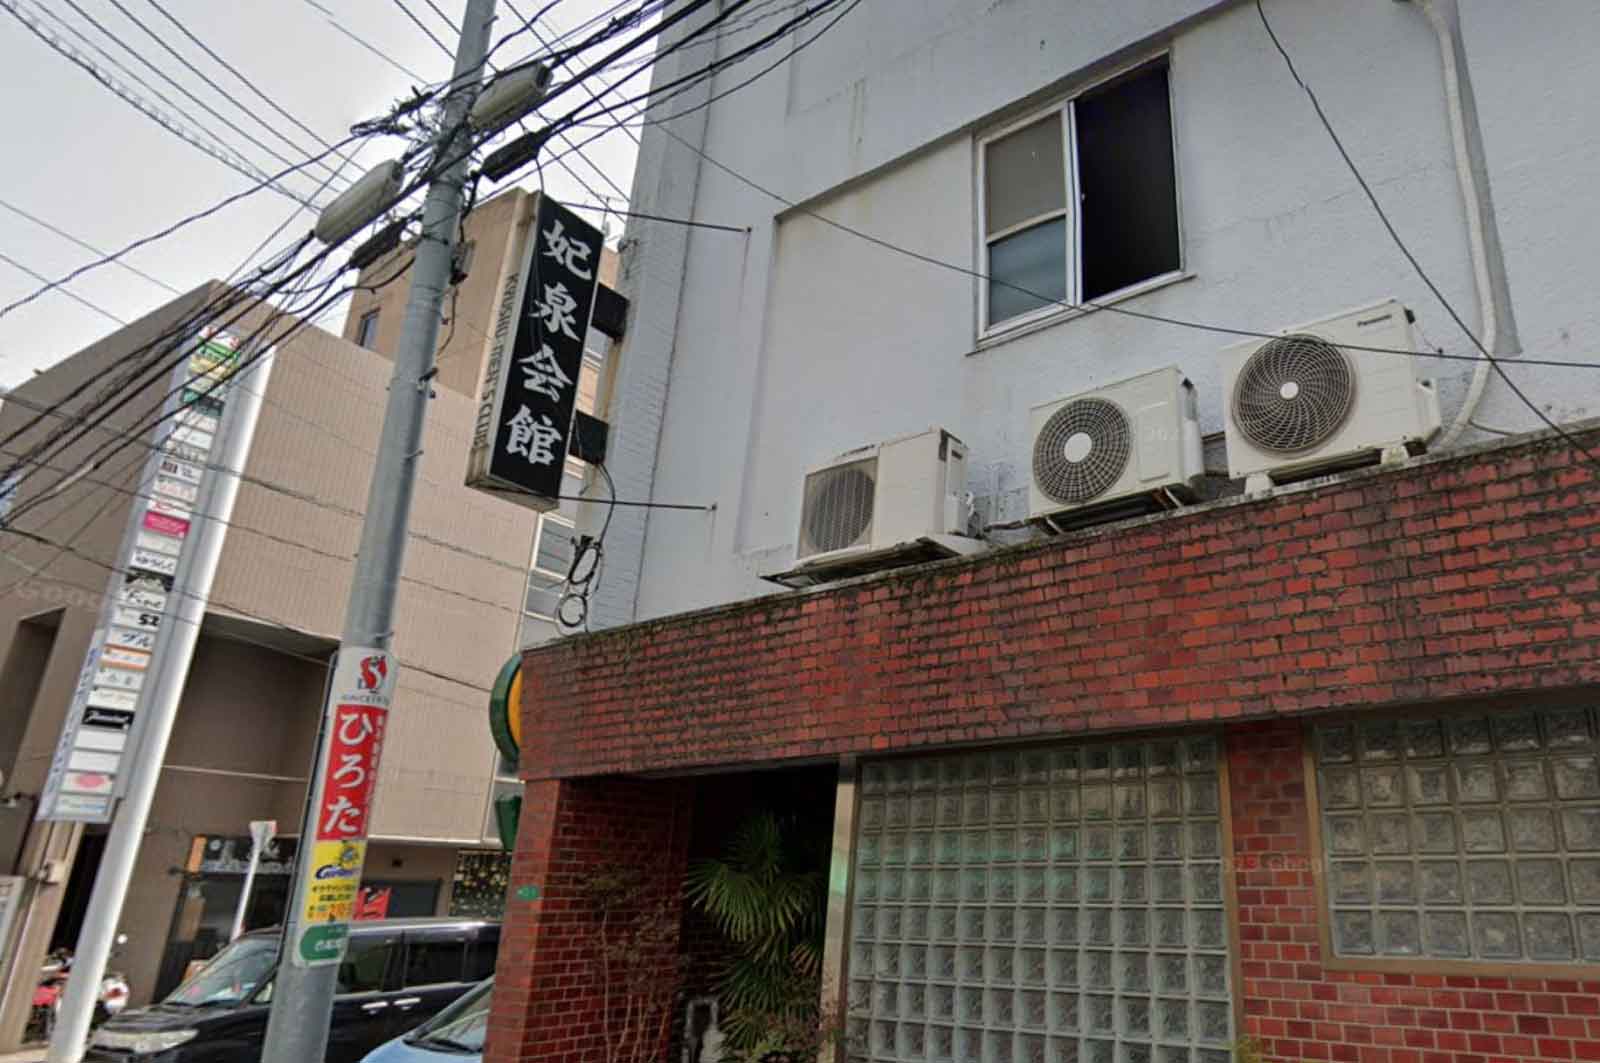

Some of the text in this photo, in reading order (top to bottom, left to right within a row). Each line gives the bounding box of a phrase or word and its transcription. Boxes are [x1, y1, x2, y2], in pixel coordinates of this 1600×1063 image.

[504, 218, 592, 466] 妃泉会館
[324, 711, 374, 835] ひろた
